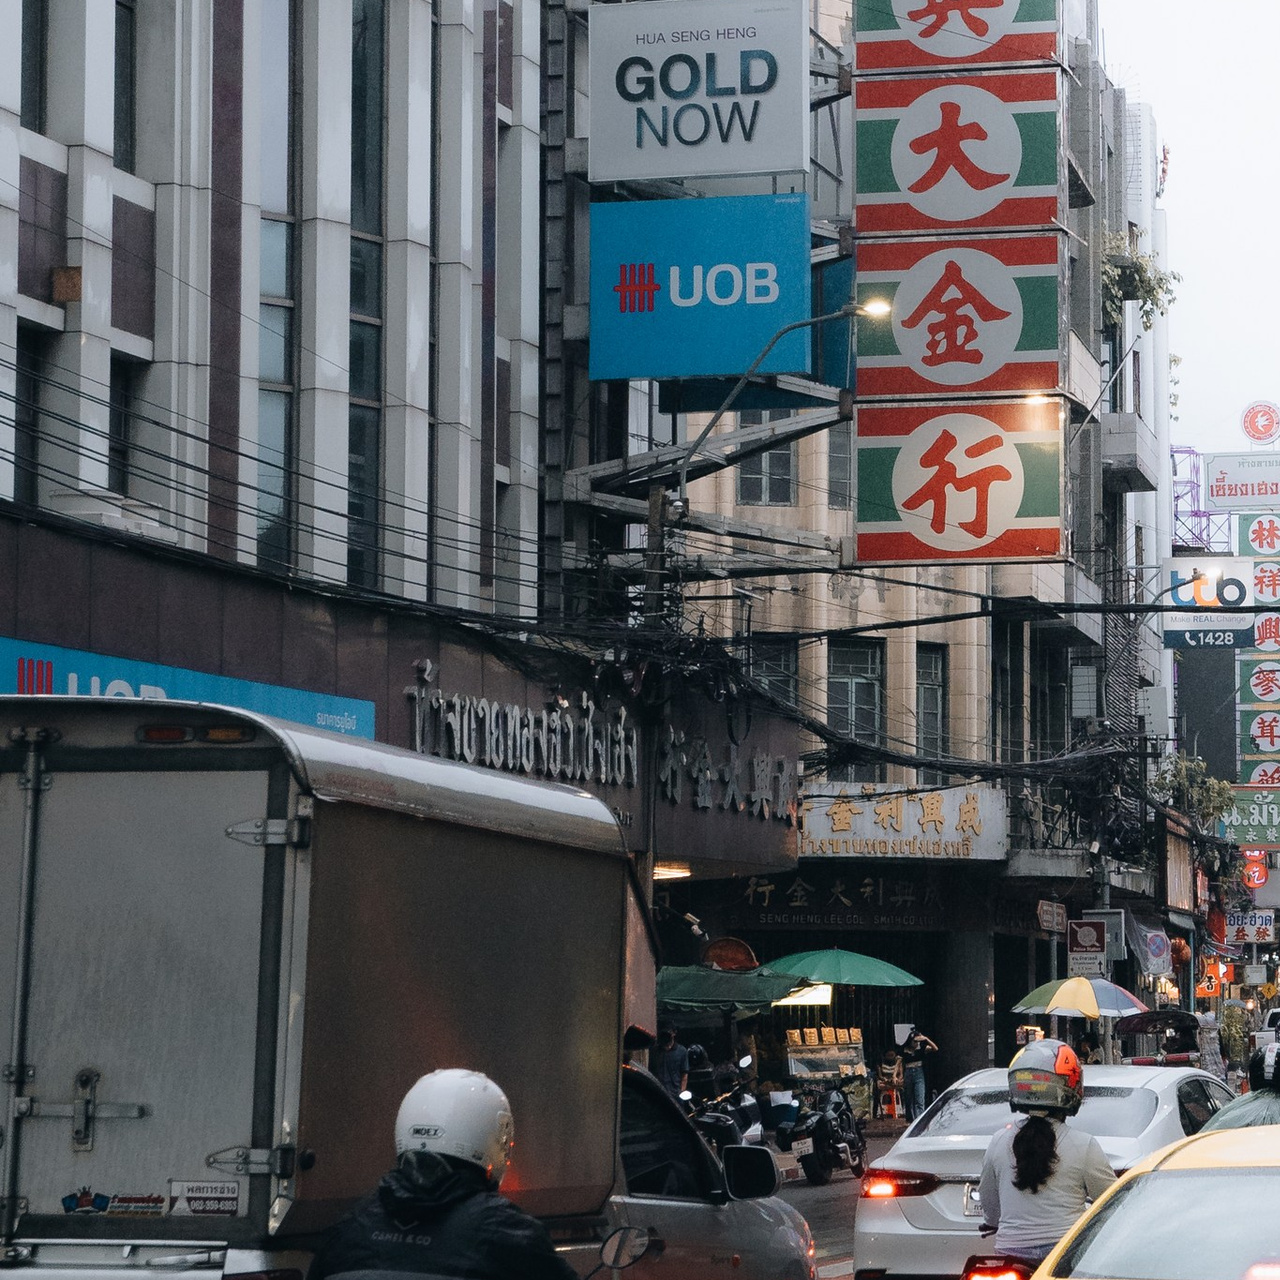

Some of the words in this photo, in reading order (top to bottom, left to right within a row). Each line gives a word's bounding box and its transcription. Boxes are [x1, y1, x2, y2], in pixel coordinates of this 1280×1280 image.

[636, 32, 666, 45] HUA
[671, 29, 711, 43] SENG
[716, 26, 757, 40] HENG
[615, 49, 778, 102] GOLD
[636, 100, 761, 149] NOW
[669, 262, 780, 308] UOB
[1170, 570, 1247, 607] ttb
[1170, 615, 1191, 624] Make
[1192, 615, 1215, 624] REAL
[1216, 615, 1247, 625] Change
[1198, 631, 1234, 646] 1428
[759, 913, 789, 924] SENG
[791, 913, 821, 924] HENG
[823, 914, 842, 924] LEE
